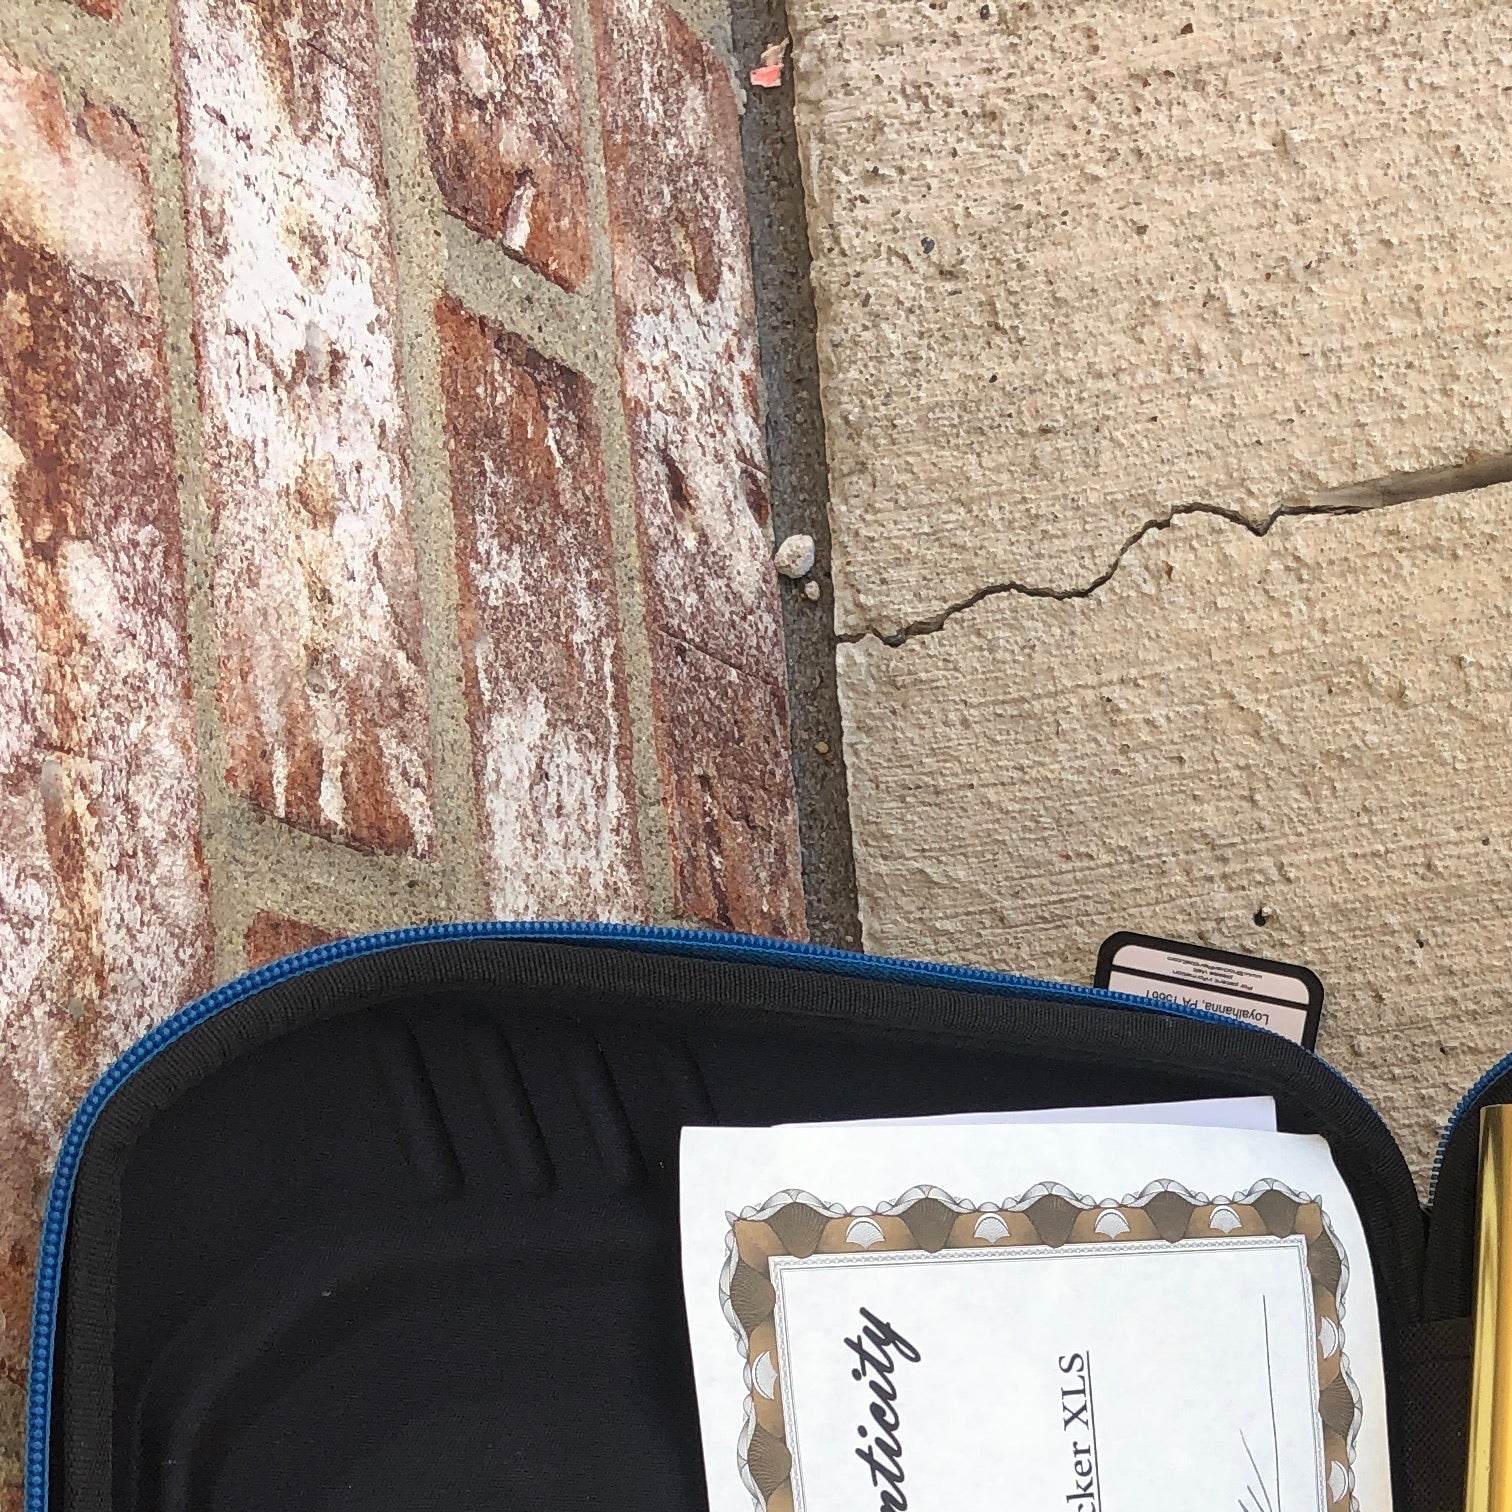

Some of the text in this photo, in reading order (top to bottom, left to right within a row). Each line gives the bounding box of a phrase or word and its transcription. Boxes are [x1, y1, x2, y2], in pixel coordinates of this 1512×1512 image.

[1172, 969, 1212, 983] information
[1183, 996, 1198, 1009] PA
[1203, 1000, 1269, 1025] Loyalhanna,
[1059, 1352, 1091, 1431] XLS
